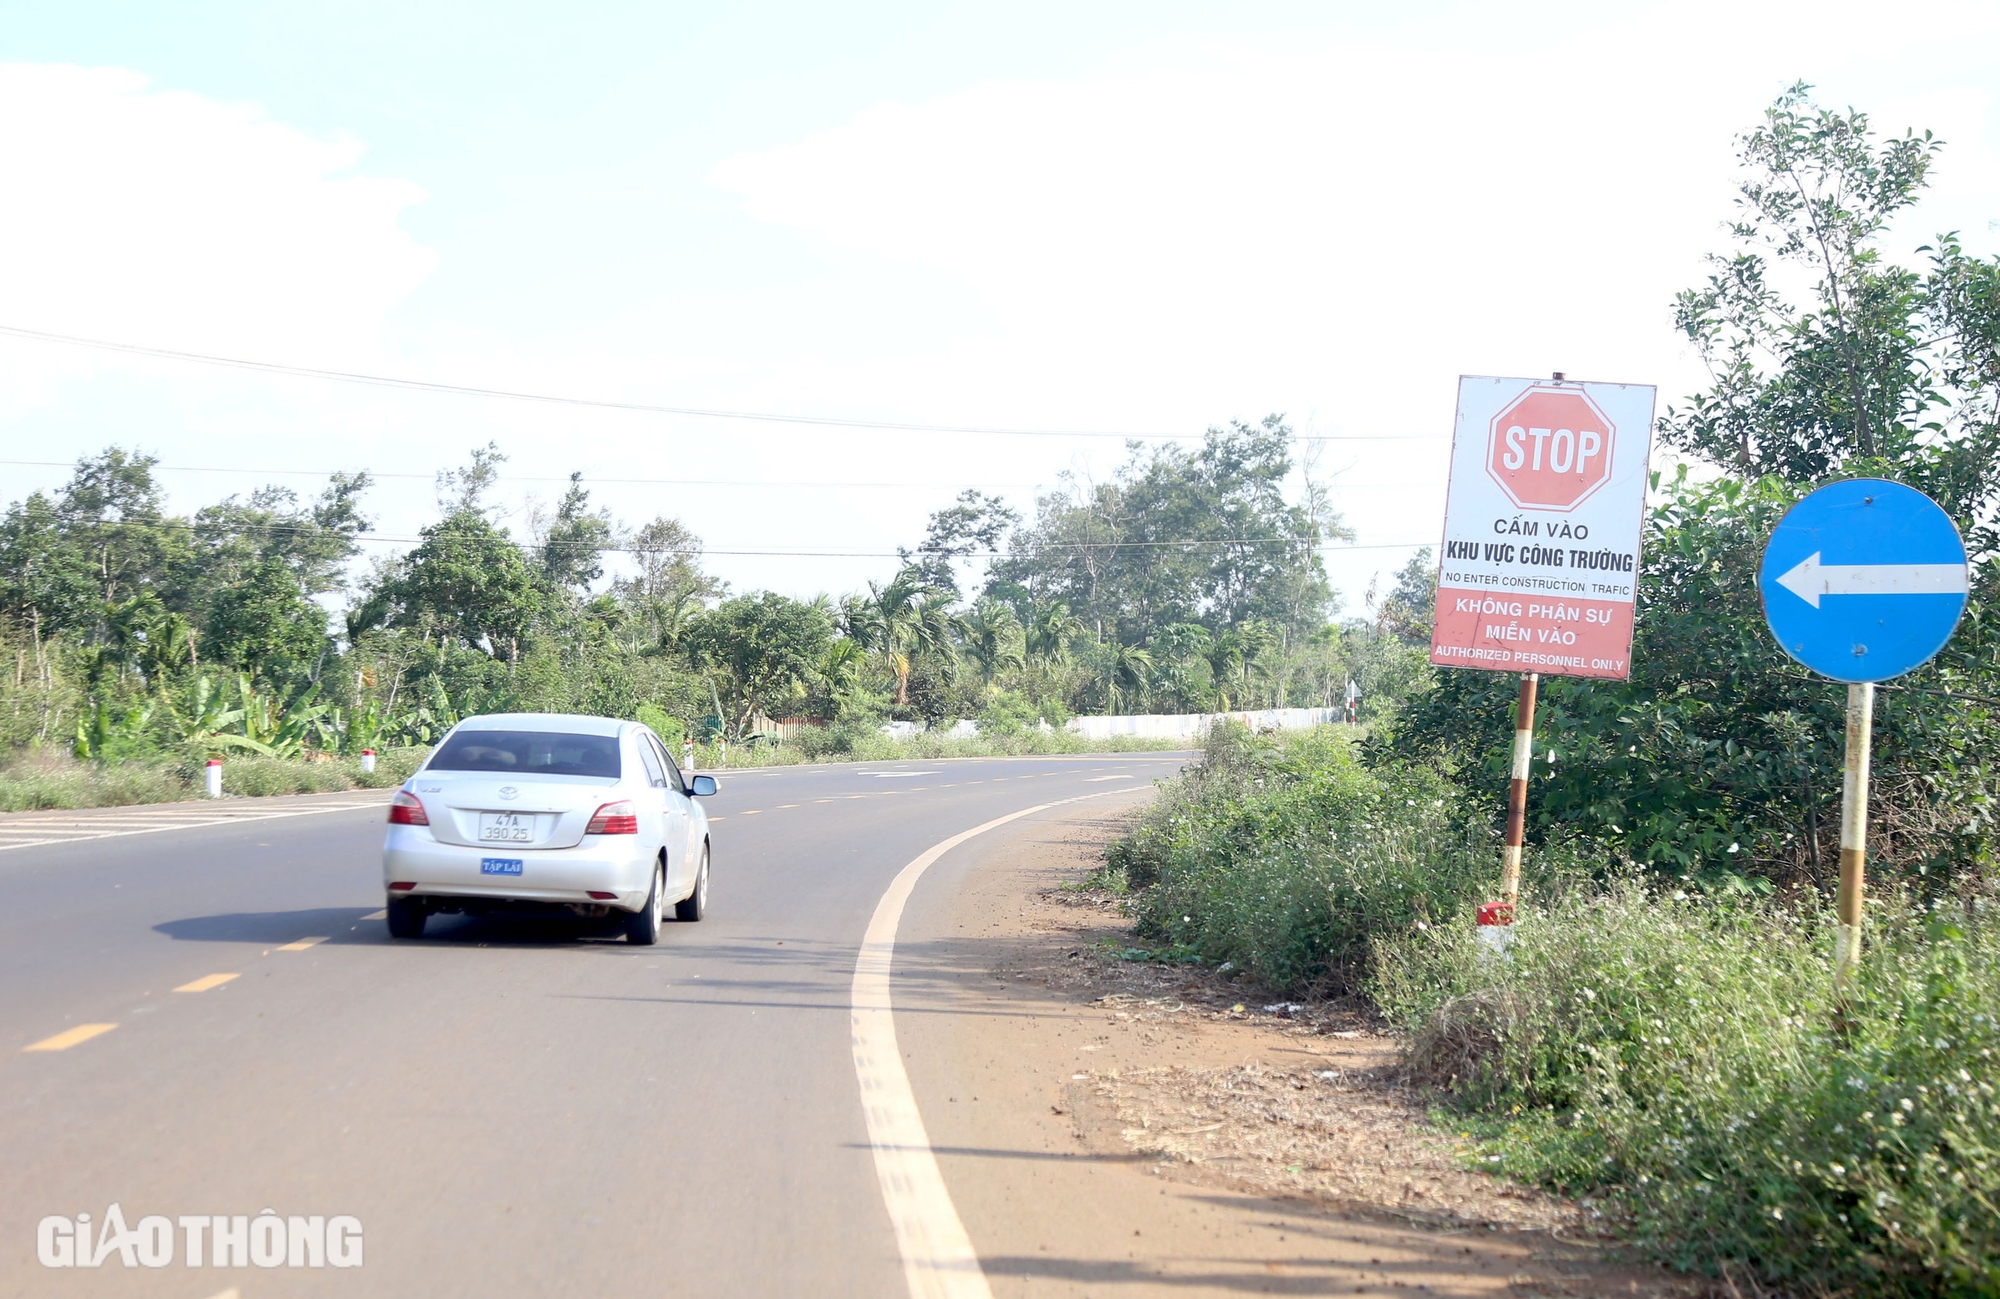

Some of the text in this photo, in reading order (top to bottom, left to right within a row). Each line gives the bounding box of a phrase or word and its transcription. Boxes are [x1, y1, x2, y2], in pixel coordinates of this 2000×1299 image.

[1503, 426, 1601, 474] STOP
[1494, 514, 1589, 540] CẤM VÀO
[1447, 541, 1633, 572] KHU VỰC CÔNG TRƯỜNG
[1445, 572, 1630, 596] NO ENTER CONSTRUCTION TRAFIC
[1456, 597, 1613, 626] KHÔNG PHẬN SỰ
[1486, 620, 1577, 645] MIỄN VÀO
[1435, 646, 1625, 671] AUTHORIZED PERSONNEL ONLY
[495, 814, 519, 827] 47A
[485, 828, 527, 840] 390.25
[483, 860, 521, 873] TẬP LÁI
